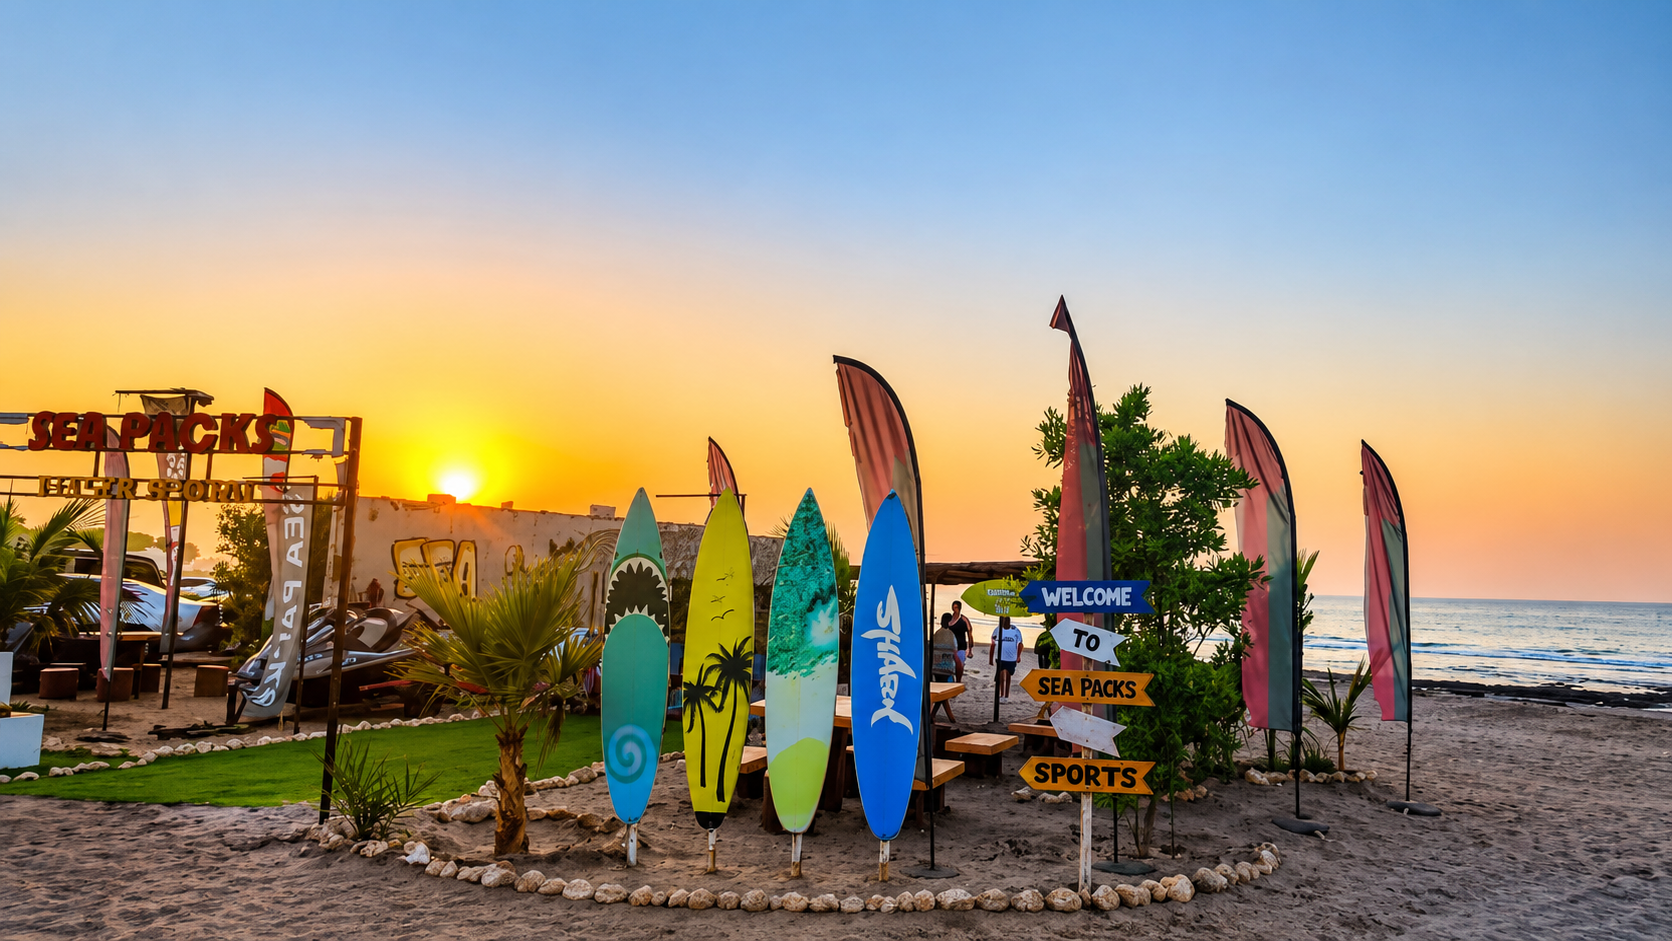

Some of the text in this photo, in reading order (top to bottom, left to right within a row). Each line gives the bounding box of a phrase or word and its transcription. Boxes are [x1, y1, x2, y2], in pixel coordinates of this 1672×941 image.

[28, 411, 275, 454] SEA PACKS
[1041, 587, 1132, 607] WELCOME
[1073, 628, 1101, 651] TO
[860, 584, 917, 736] SHARK
[1038, 676, 1137, 699] SEA PACKS
[1034, 762, 1137, 788] SPORTS
